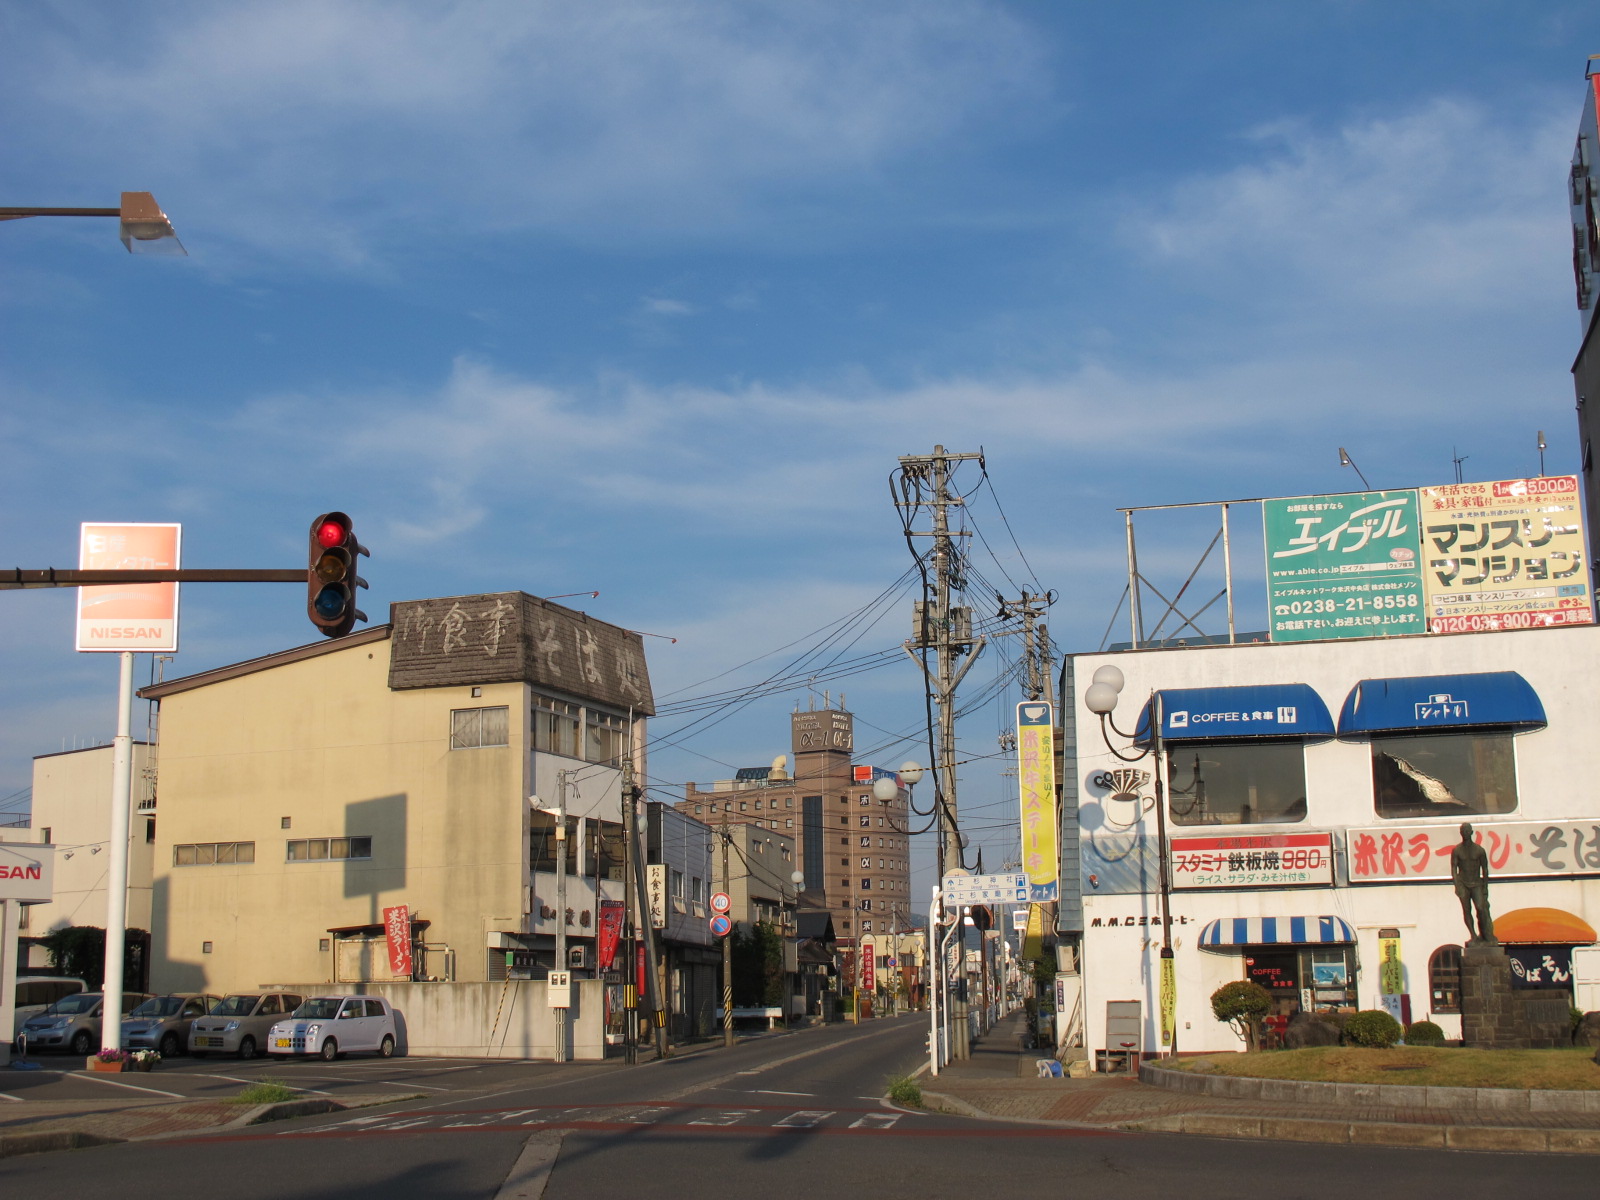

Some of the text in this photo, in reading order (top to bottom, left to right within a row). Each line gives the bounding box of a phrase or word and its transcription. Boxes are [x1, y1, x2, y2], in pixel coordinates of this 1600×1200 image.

[1272, 498, 1408, 559] エイブル
[1426, 516, 1579, 554] マンスリー
[1272, 567, 1340, 577] www.able.co.jp
[1341, 564, 1366, 572] エイブル
[1430, 549, 1582, 587] マンション
[1290, 594, 1419, 614] 0238-21-8558
[90, 627, 162, 639] NISSAN
[1192, 711, 1240, 724] COFFEE
[1241, 713, 1249, 721] &
[1420, 704, 1462, 719] シャトル
[1093, 768, 1151, 788] COFFEE
[1022, 729, 1043, 871] 米沢牛ステーキ
[1176, 851, 1280, 873] スタミナ鉄板焼
[1281, 849, 1327, 870] 980円
[650, 867, 662, 916] お食事処
[715, 898, 727, 907] 40
[387, 908, 406, 973] 米沢ラーメン
